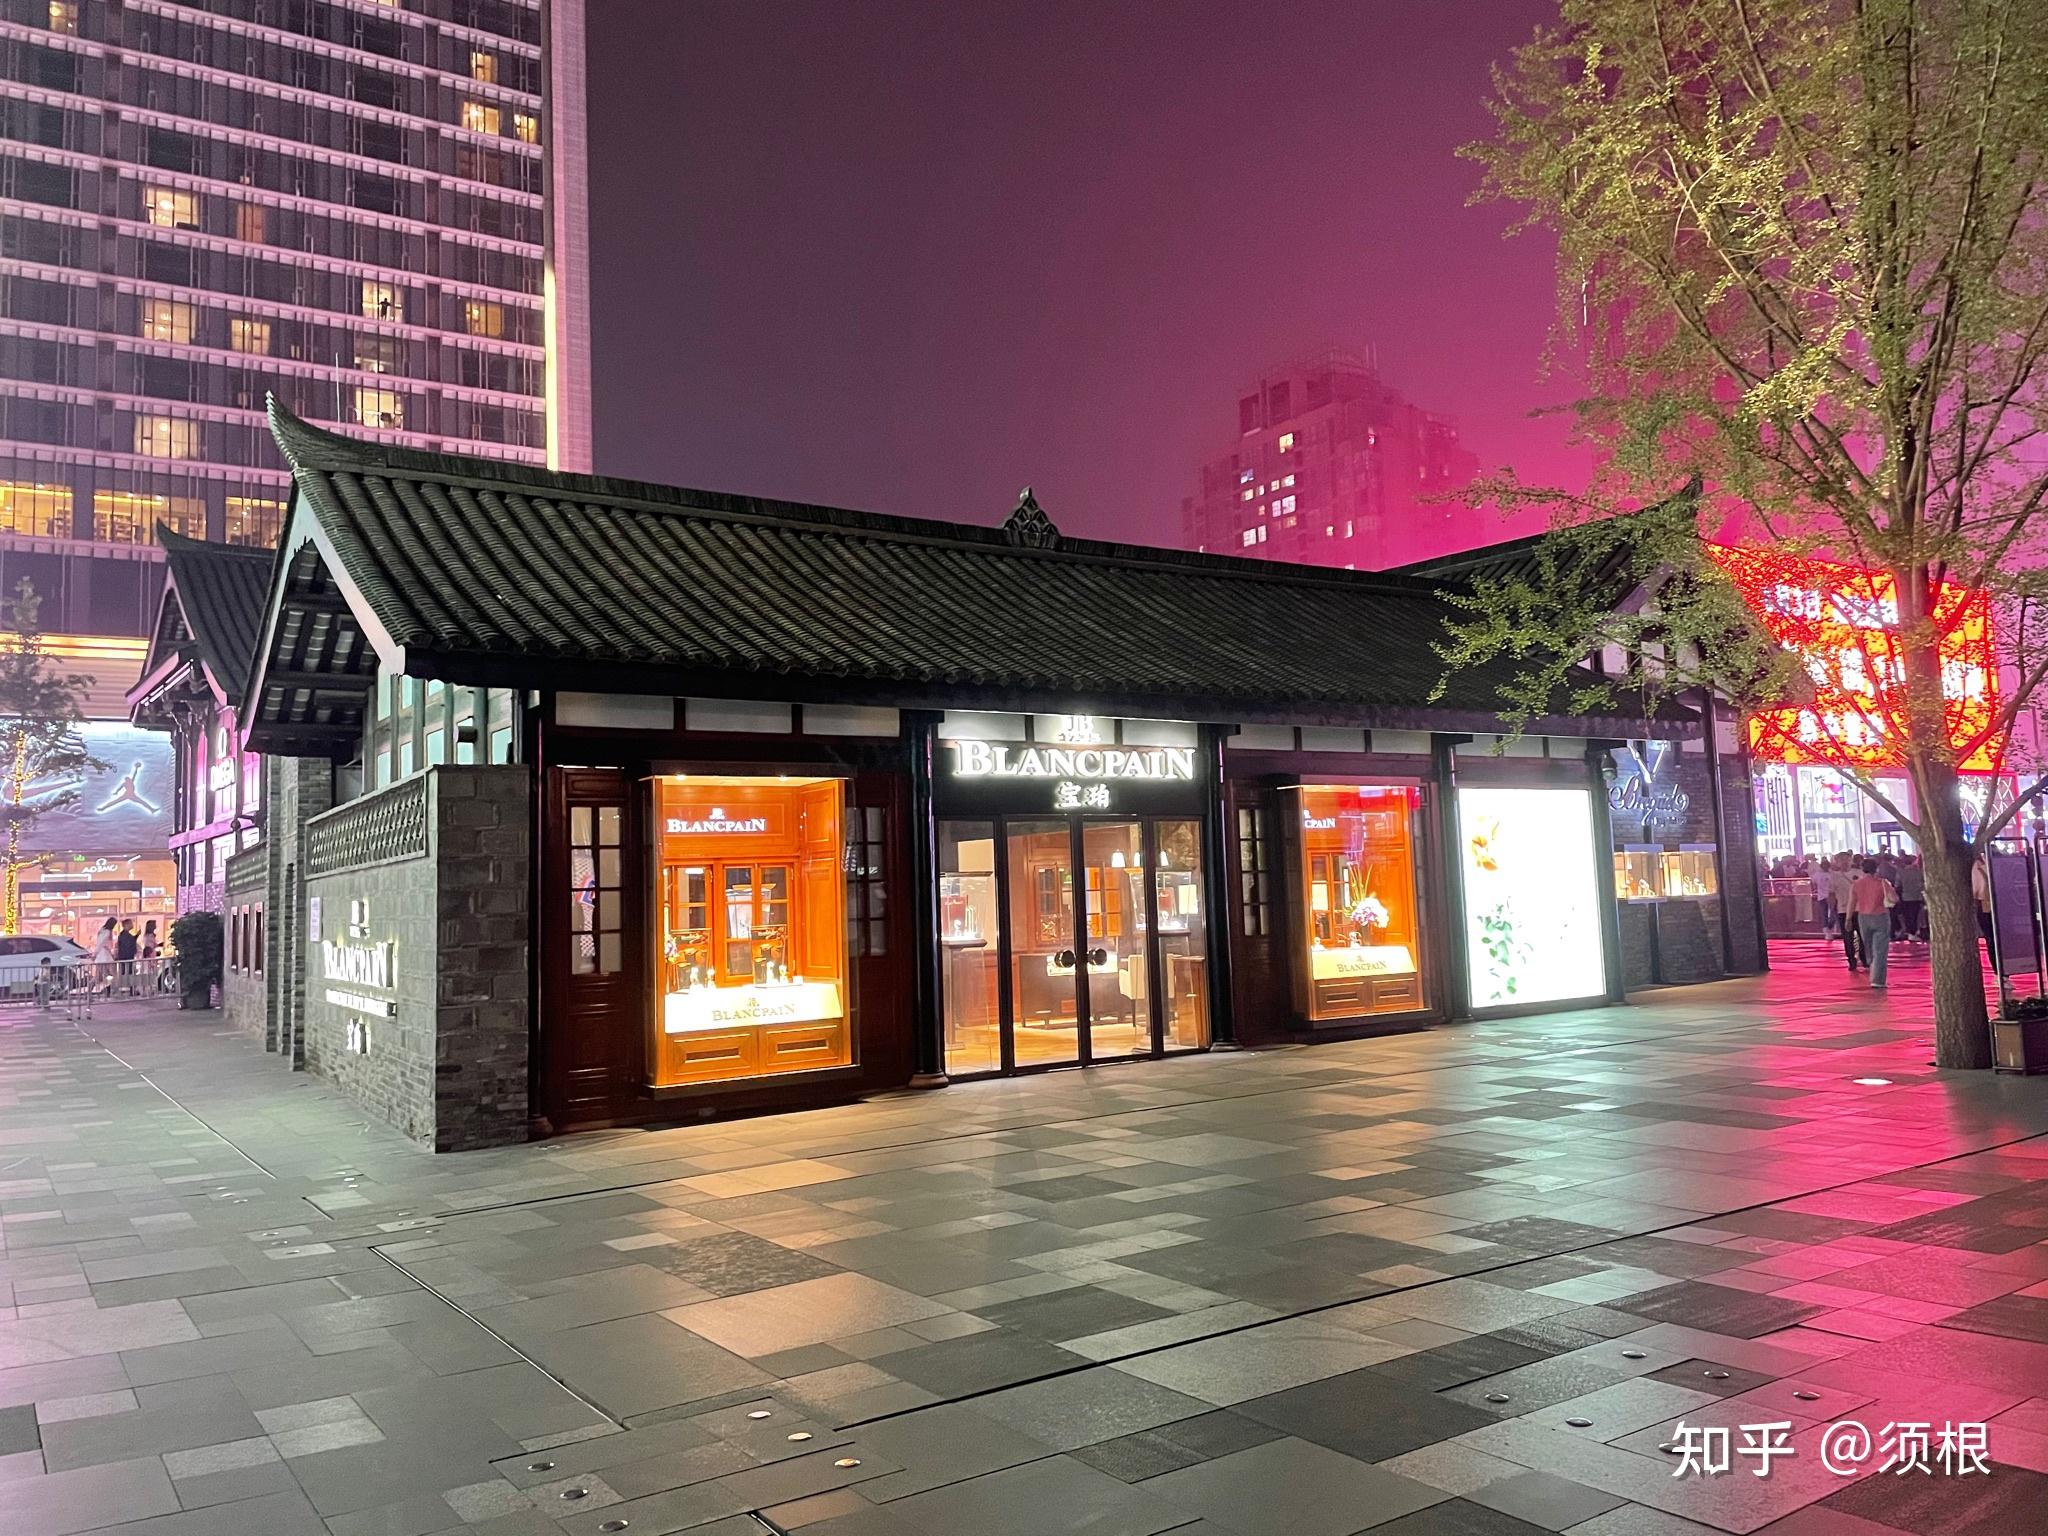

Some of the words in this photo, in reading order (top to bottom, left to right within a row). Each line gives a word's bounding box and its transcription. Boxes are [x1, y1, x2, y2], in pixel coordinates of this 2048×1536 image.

[953, 740, 1196, 780] BLANCPAIN
[1055, 782, 1111, 808] 宝珀
[667, 819, 766, 832] BLANCPAIN
[1337, 960, 1387, 972] BLANCPAIN
[712, 1004, 796, 1021] BLANCPAIN
